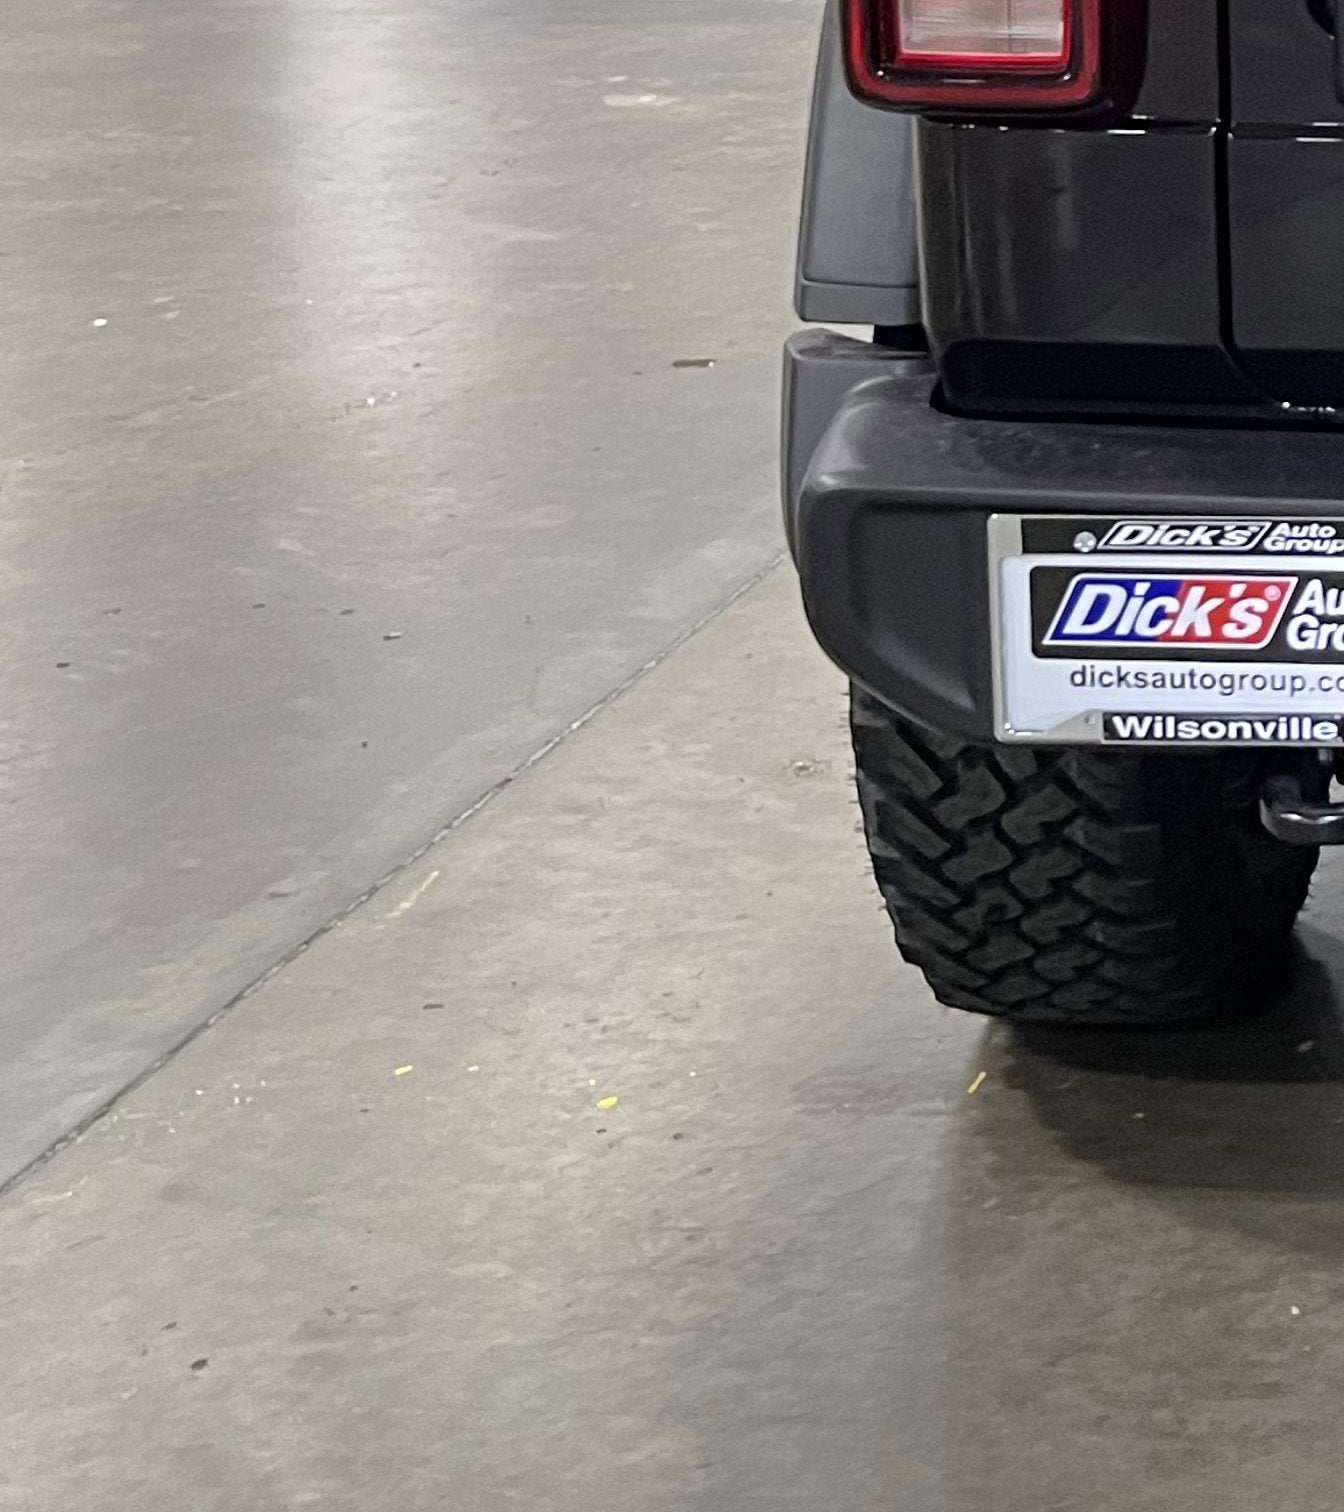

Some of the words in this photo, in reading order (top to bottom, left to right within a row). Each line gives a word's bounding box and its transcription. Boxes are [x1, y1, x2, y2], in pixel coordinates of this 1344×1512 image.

[1108, 523, 1259, 548] Dick's
[1269, 522, 1337, 540] Auto
[1061, 582, 1272, 639] Dick's
[1112, 714, 1339, 742] Wilsonville
